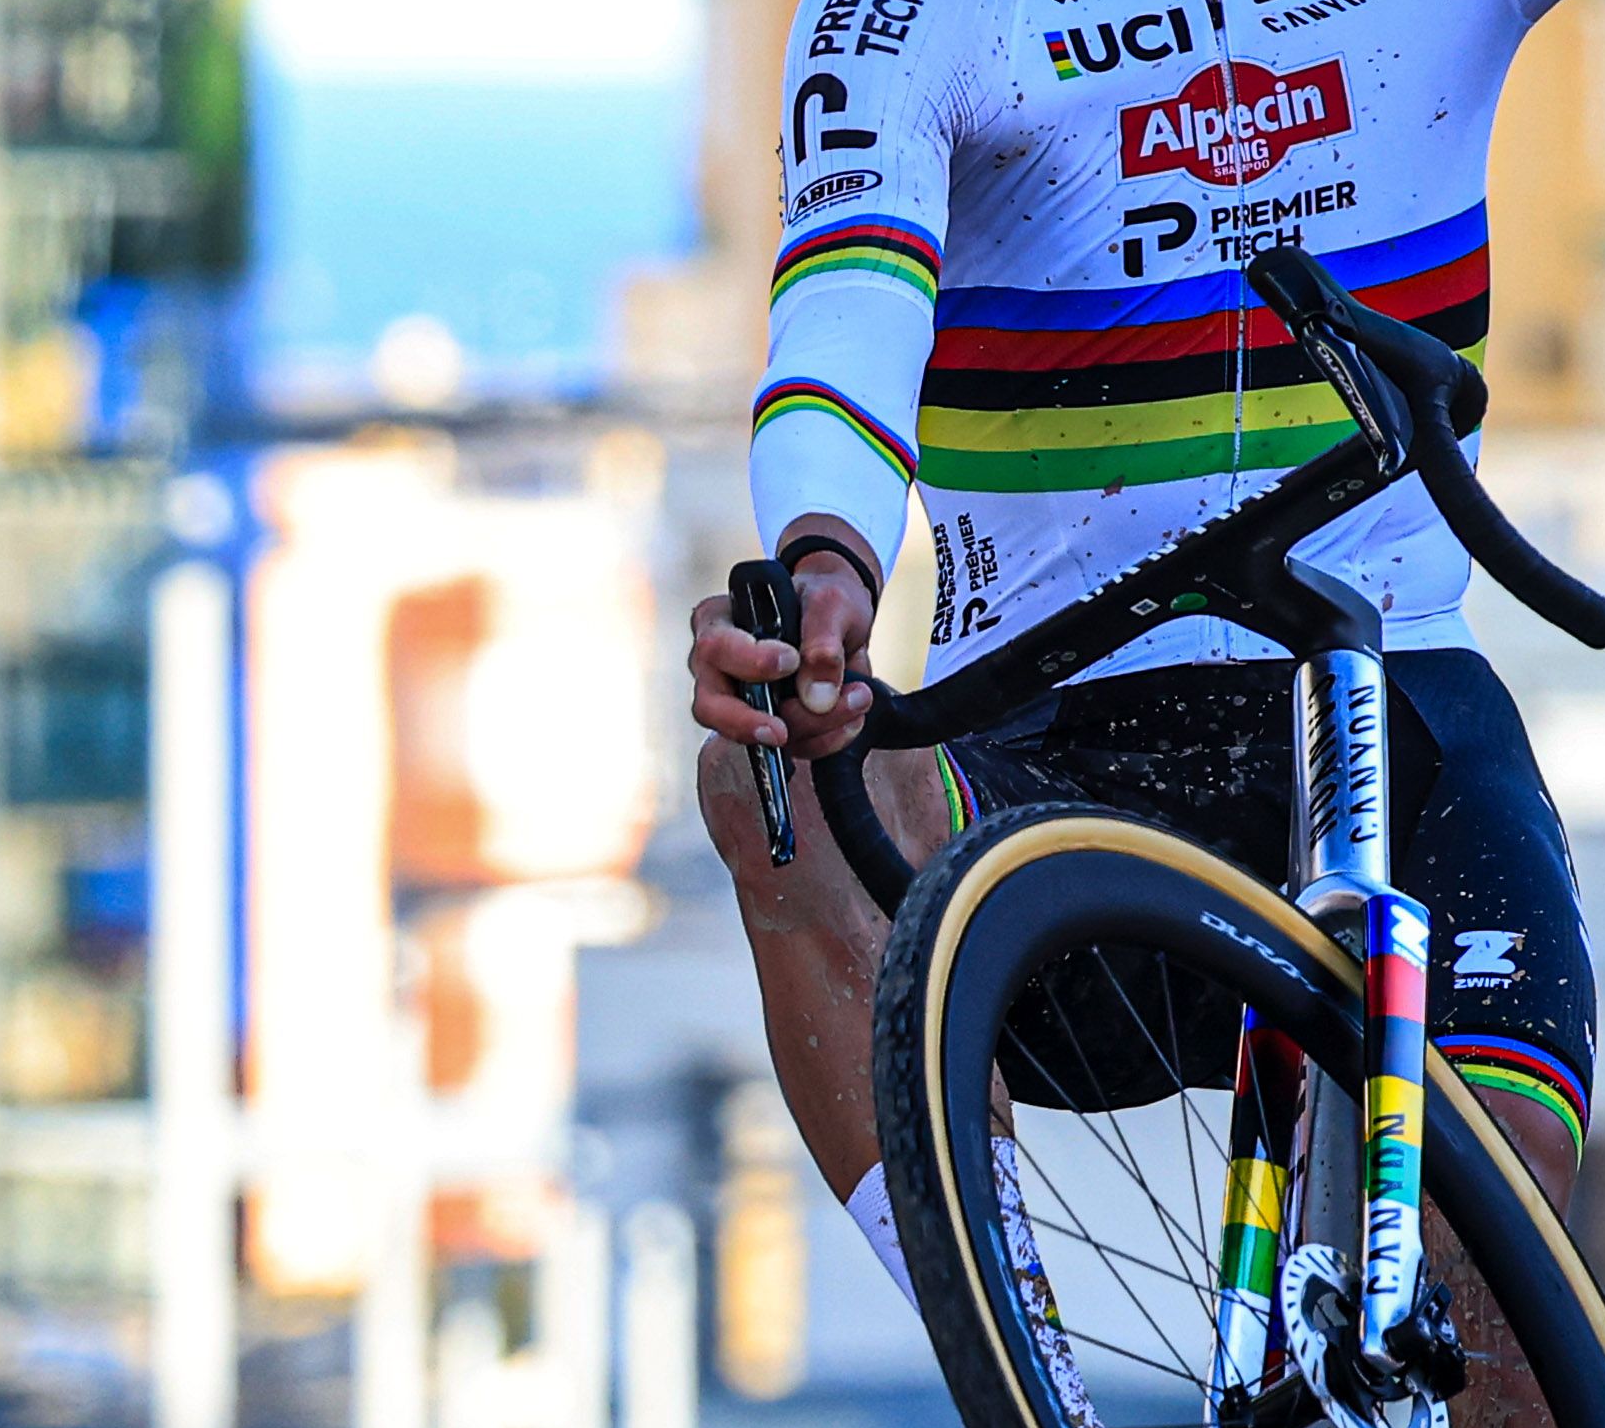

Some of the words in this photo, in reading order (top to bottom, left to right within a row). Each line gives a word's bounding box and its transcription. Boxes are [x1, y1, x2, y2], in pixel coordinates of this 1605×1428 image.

[1067, 7, 1194, 73] UCI
[1139, 81, 1326, 161] Alpecin
[794, 175, 866, 215] ABUS
[1210, 180, 1358, 234] PREMIER
[1212, 224, 1302, 263] TECH
[957, 511, 983, 593] PREMIER
[978, 536, 999, 588] TECH
[1308, 673, 1338, 853] CANYON
[1348, 684, 1378, 845] CANYON
[1453, 977, 1513, 990] ZWIFT
[1366, 1112, 1406, 1296] CANYON
